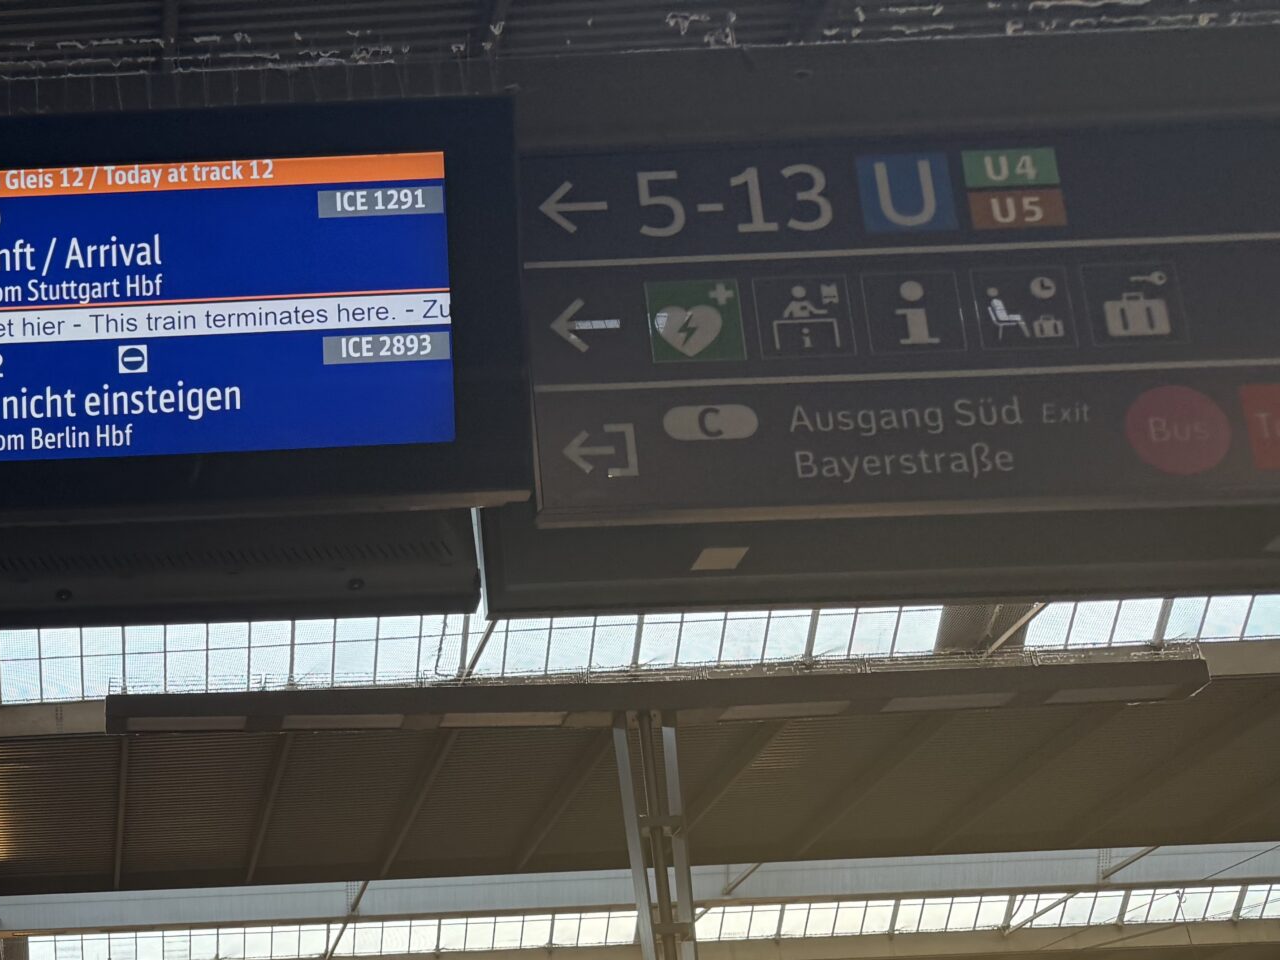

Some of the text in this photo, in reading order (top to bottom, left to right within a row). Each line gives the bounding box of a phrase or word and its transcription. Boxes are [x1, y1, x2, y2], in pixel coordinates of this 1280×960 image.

[5, 169, 54, 191] Gleis
[60, 168, 84, 188] 12
[89, 166, 98, 191] /
[103, 164, 161, 189] Today
[167, 163, 188, 183] at
[193, 161, 243, 182] track
[249, 160, 274, 180] 12
[983, 154, 1039, 181] U4
[335, 192, 368, 212] ICE
[373, 189, 426, 211] 1291
[638, 158, 938, 239] 5-13 U
[990, 195, 1044, 224] U5
[43, 237, 57, 275] /
[65, 233, 162, 270] Arrival
[27, 277, 120, 305] Stuttgart
[126, 273, 163, 298] Hbf
[22, 317, 66, 338] hier
[89, 312, 138, 334] This
[146, 310, 197, 332] train
[205, 305, 329, 330] terminates
[336, 301, 396, 324] here.
[341, 338, 373, 358] ICE
[378, 335, 432, 357] 2893
[2, 386, 77, 419] nicht
[84, 381, 242, 420] einsteigen
[789, 396, 1091, 435] Ausgang Süd Exit
[31, 426, 90, 450] Berlin
[97, 424, 133, 447] Hbf
[697, 407, 724, 438] C
[1148, 416, 1210, 442] Bus
[794, 442, 1016, 484] Bayerstraße
